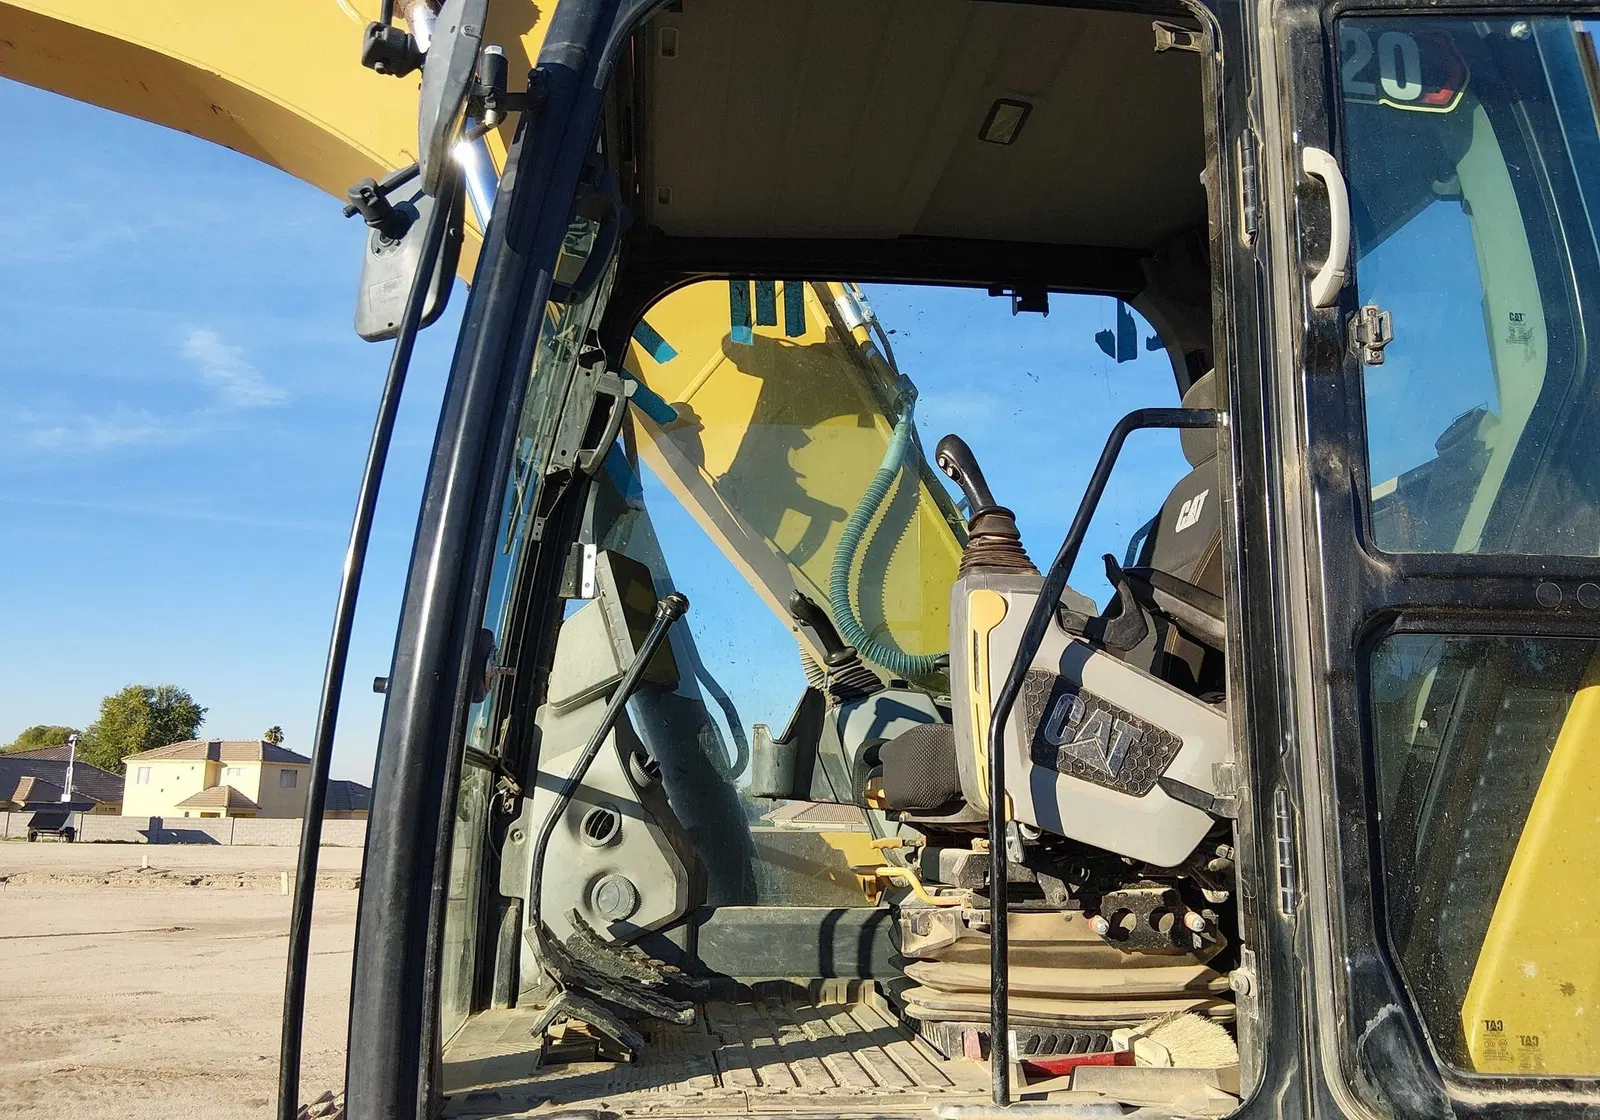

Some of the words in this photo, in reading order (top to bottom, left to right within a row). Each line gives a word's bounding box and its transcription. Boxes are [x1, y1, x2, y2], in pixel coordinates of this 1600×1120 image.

[1509, 312, 1524, 321] CAT
[1175, 488, 1210, 533] CAT
[1044, 693, 1144, 778] CAT
